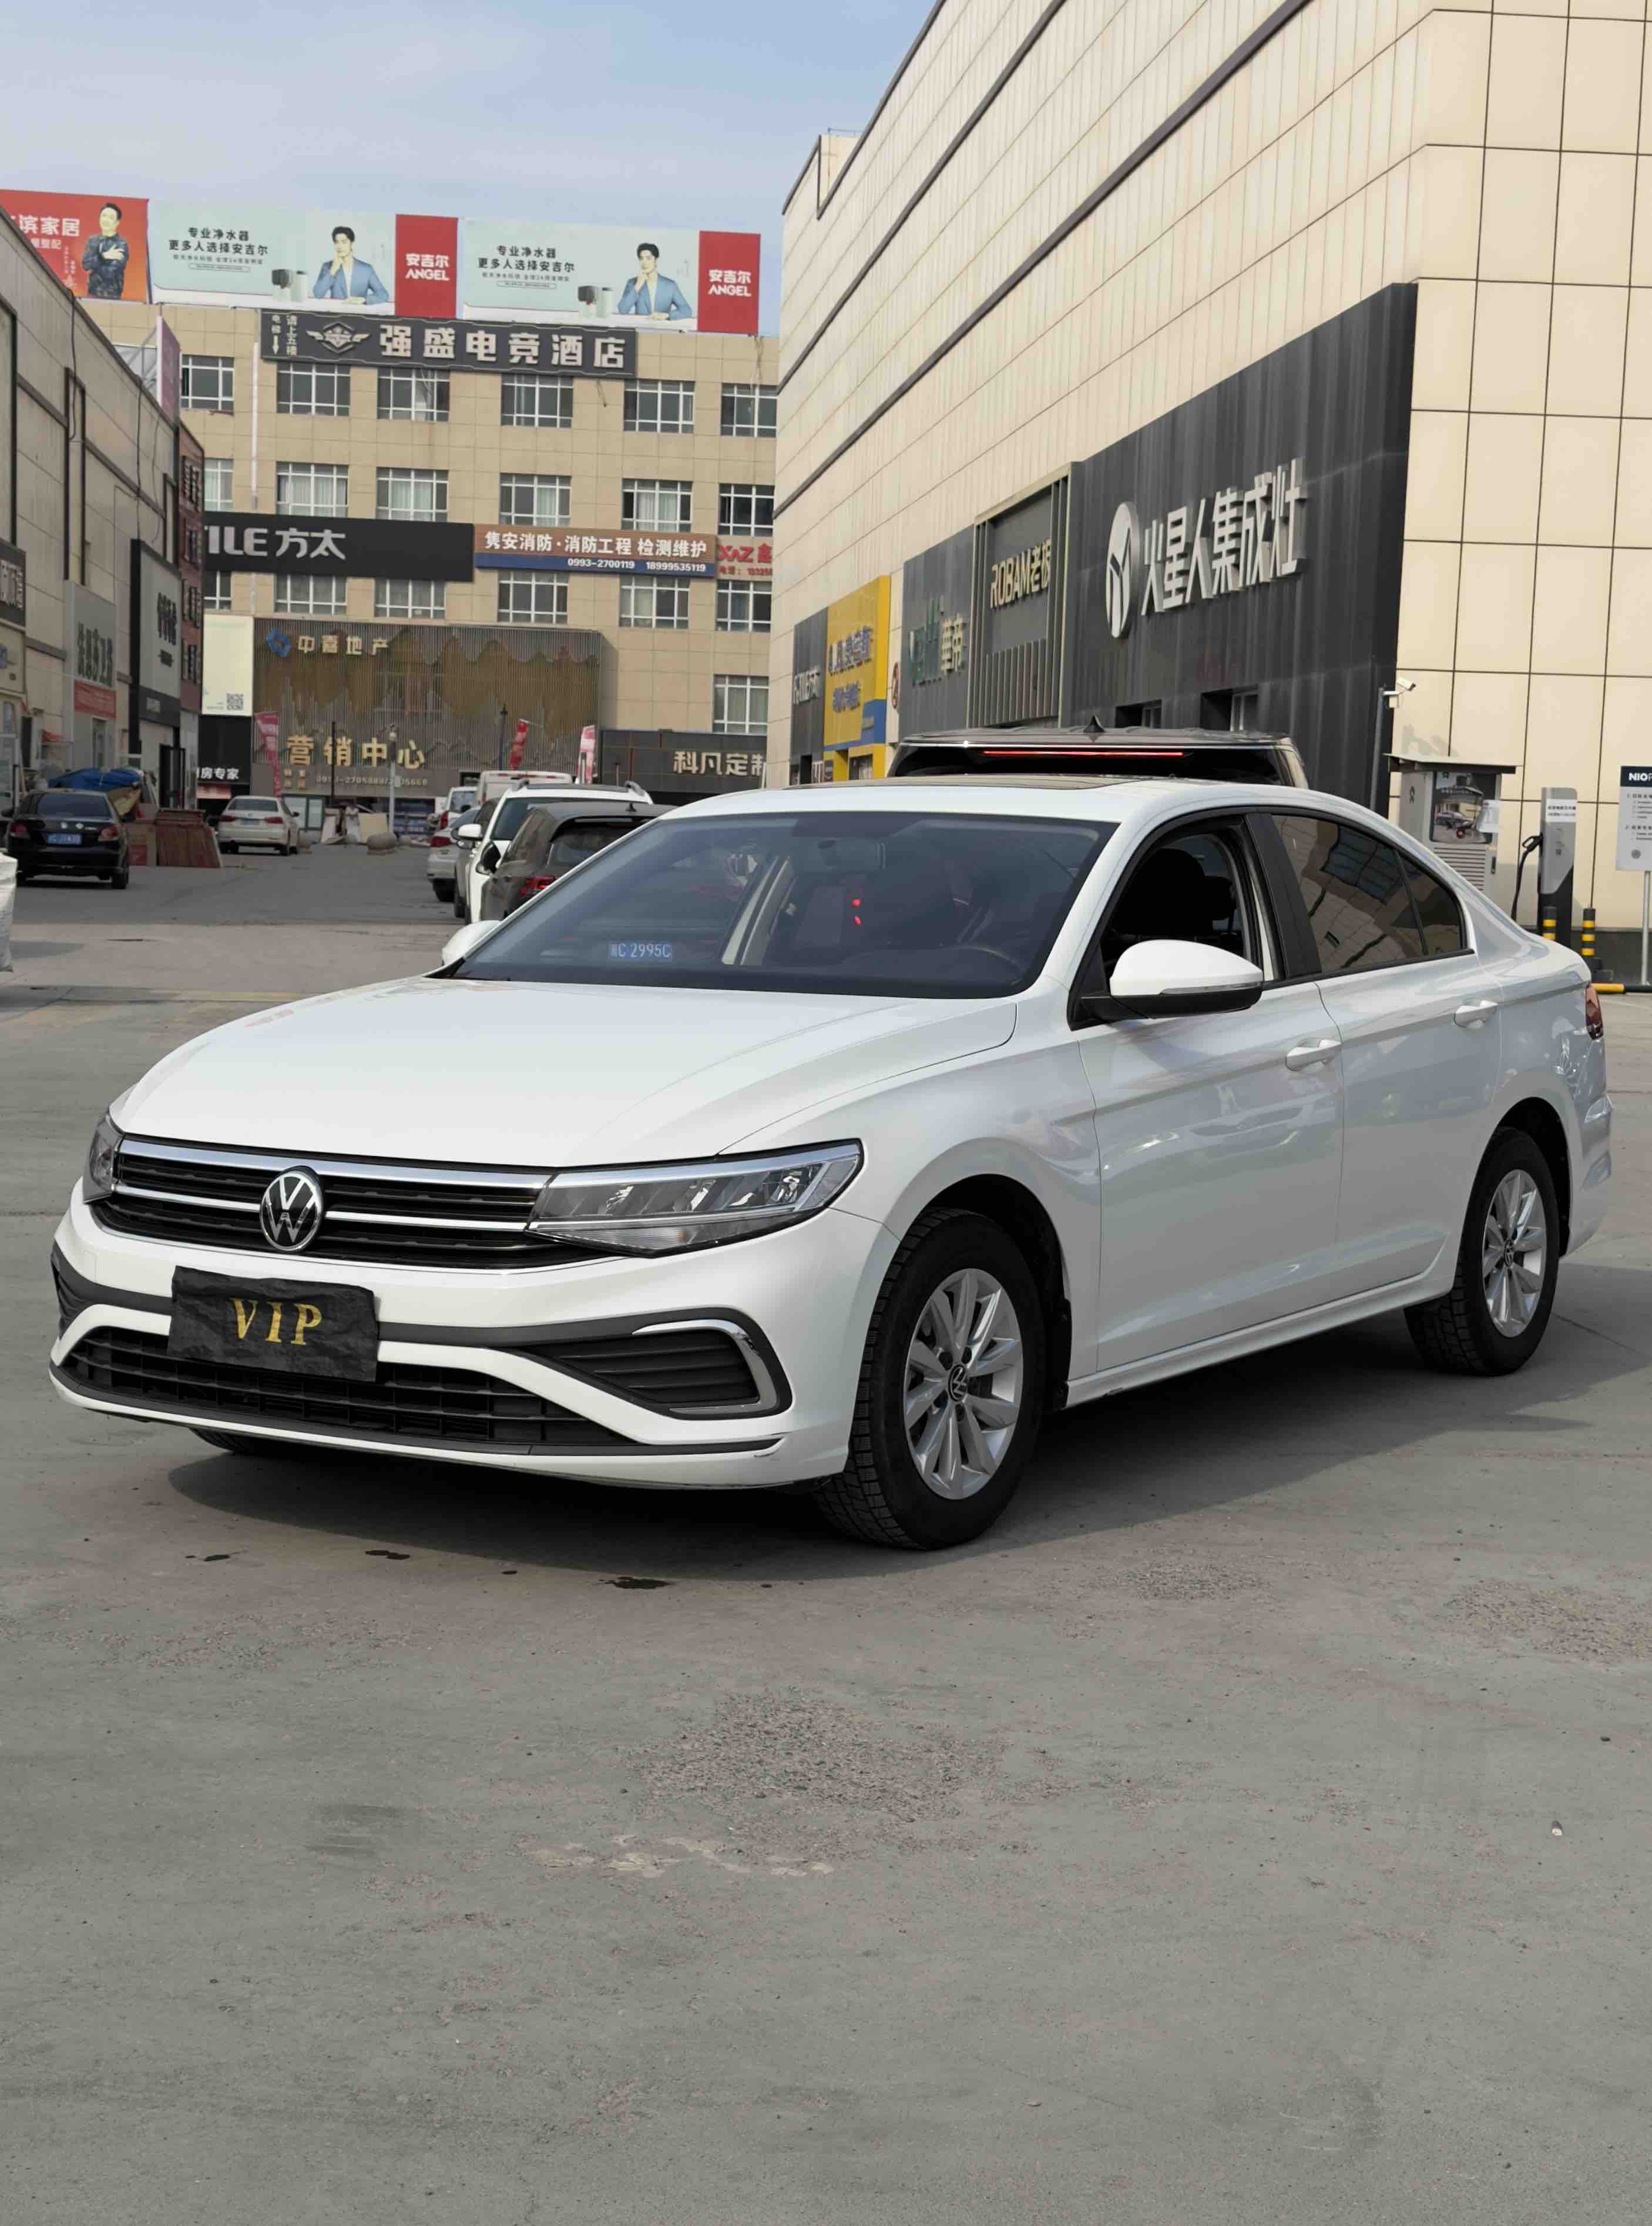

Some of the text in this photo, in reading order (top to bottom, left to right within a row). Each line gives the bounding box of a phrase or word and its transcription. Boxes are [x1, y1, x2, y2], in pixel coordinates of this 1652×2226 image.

[10, 214, 80, 236] 滨家居
[188, 227, 249, 242] 专业净水器
[169, 239, 268, 256] 更多人选择安吉尔
[497, 245, 556, 259] 专业净水器
[405, 253, 449, 268] 安吉尔
[478, 257, 575, 273] 更多人选择安吉尔
[405, 268, 450, 281] ANGEL
[709, 269, 752, 284] 安吉尔
[708, 284, 752, 297] ANGEL
[380, 324, 626, 368] 强盛电竞酒店
[204, 525, 346, 560] ILE 方太
[1140, 457, 1306, 616] 火星人集成灶
[637, 538, 707, 558] 检测维护
[568, 558, 706, 572] 0993-2700119 18999535119
[286, 734, 425, 770] 营销中心
[673, 750, 764, 776] 科凡定制
[196, 767, 239, 780] 房专家
[230, 1298, 322, 1345] VIP
